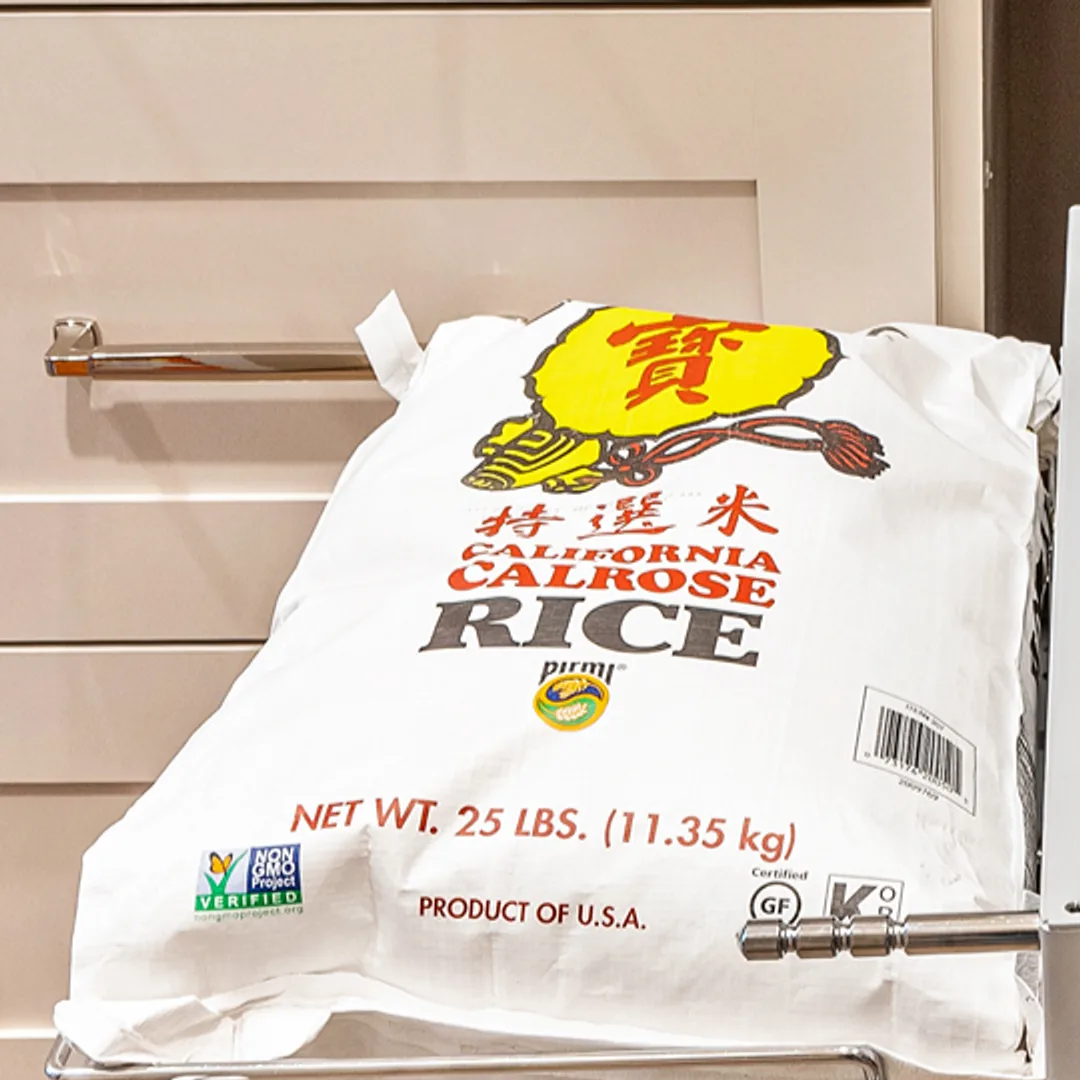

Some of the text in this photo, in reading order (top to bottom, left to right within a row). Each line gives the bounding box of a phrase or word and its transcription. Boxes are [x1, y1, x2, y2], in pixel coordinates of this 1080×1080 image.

[460, 542, 782, 575] CALIFORNIA
[447, 560, 777, 609] CALROSE
[418, 596, 764, 668] RICE
[290, 797, 797, 864] NET WT. 25 LBS. (11.35 kg)
[255, 847, 295, 864] NON
[252, 861, 296, 877] GMO
[751, 867, 809, 881] Certified
[252, 876, 296, 891] Project
[200, 891, 298, 910] VERIFIED
[760, 896, 791, 915] GF
[418, 896, 648, 931] PRODUCT OF U.S.A.
